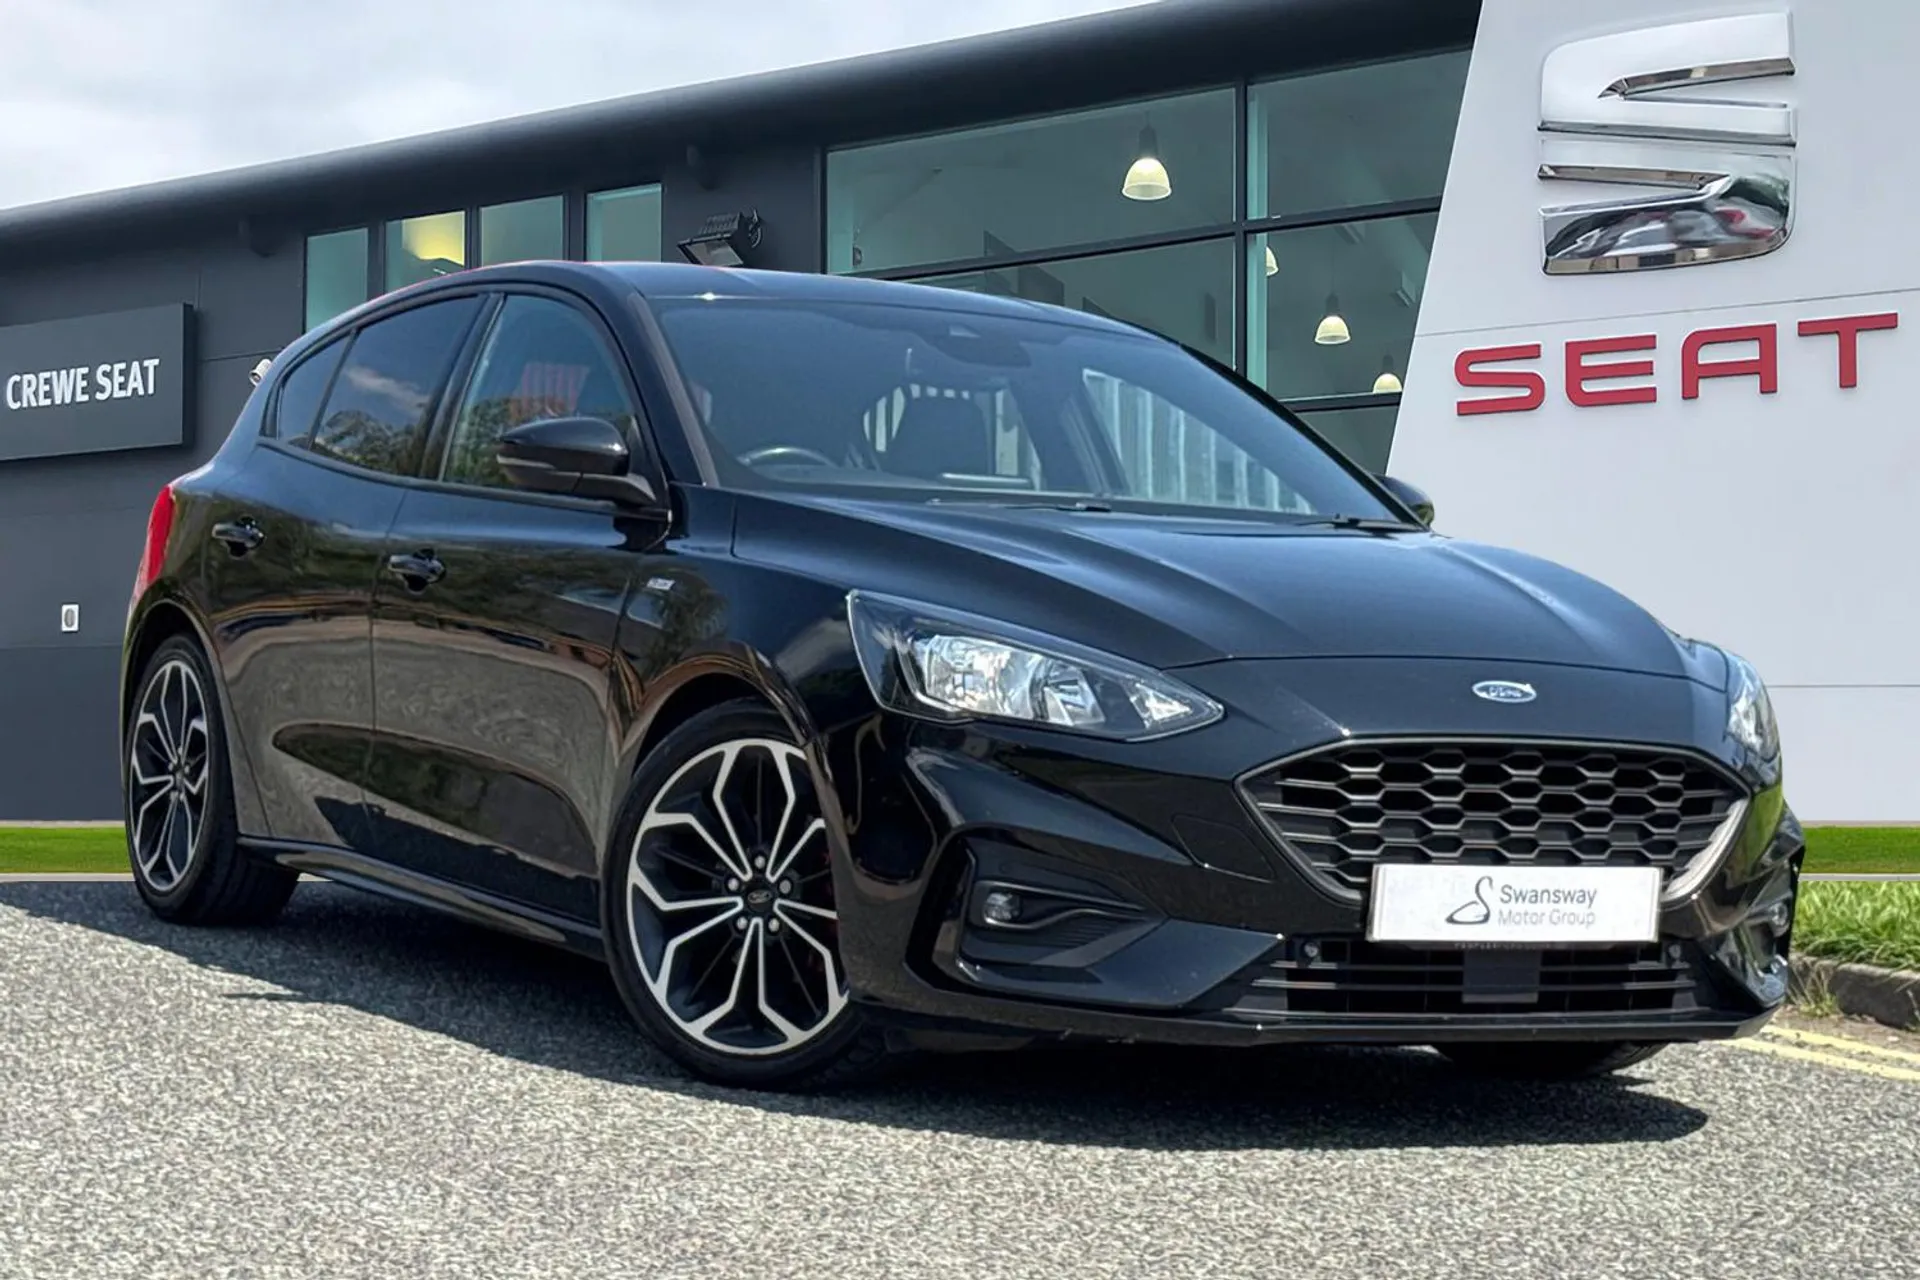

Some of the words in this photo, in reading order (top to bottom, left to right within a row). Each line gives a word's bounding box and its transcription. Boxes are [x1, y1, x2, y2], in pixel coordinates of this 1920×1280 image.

[6, 366, 90, 410] CREWE
[94, 357, 161, 401] SEAT
[1454, 312, 1899, 416] SEAT
[1499, 884, 1598, 909] Swansway
[1498, 908, 1546, 926] Motor
[1549, 908, 1597, 929] Group
